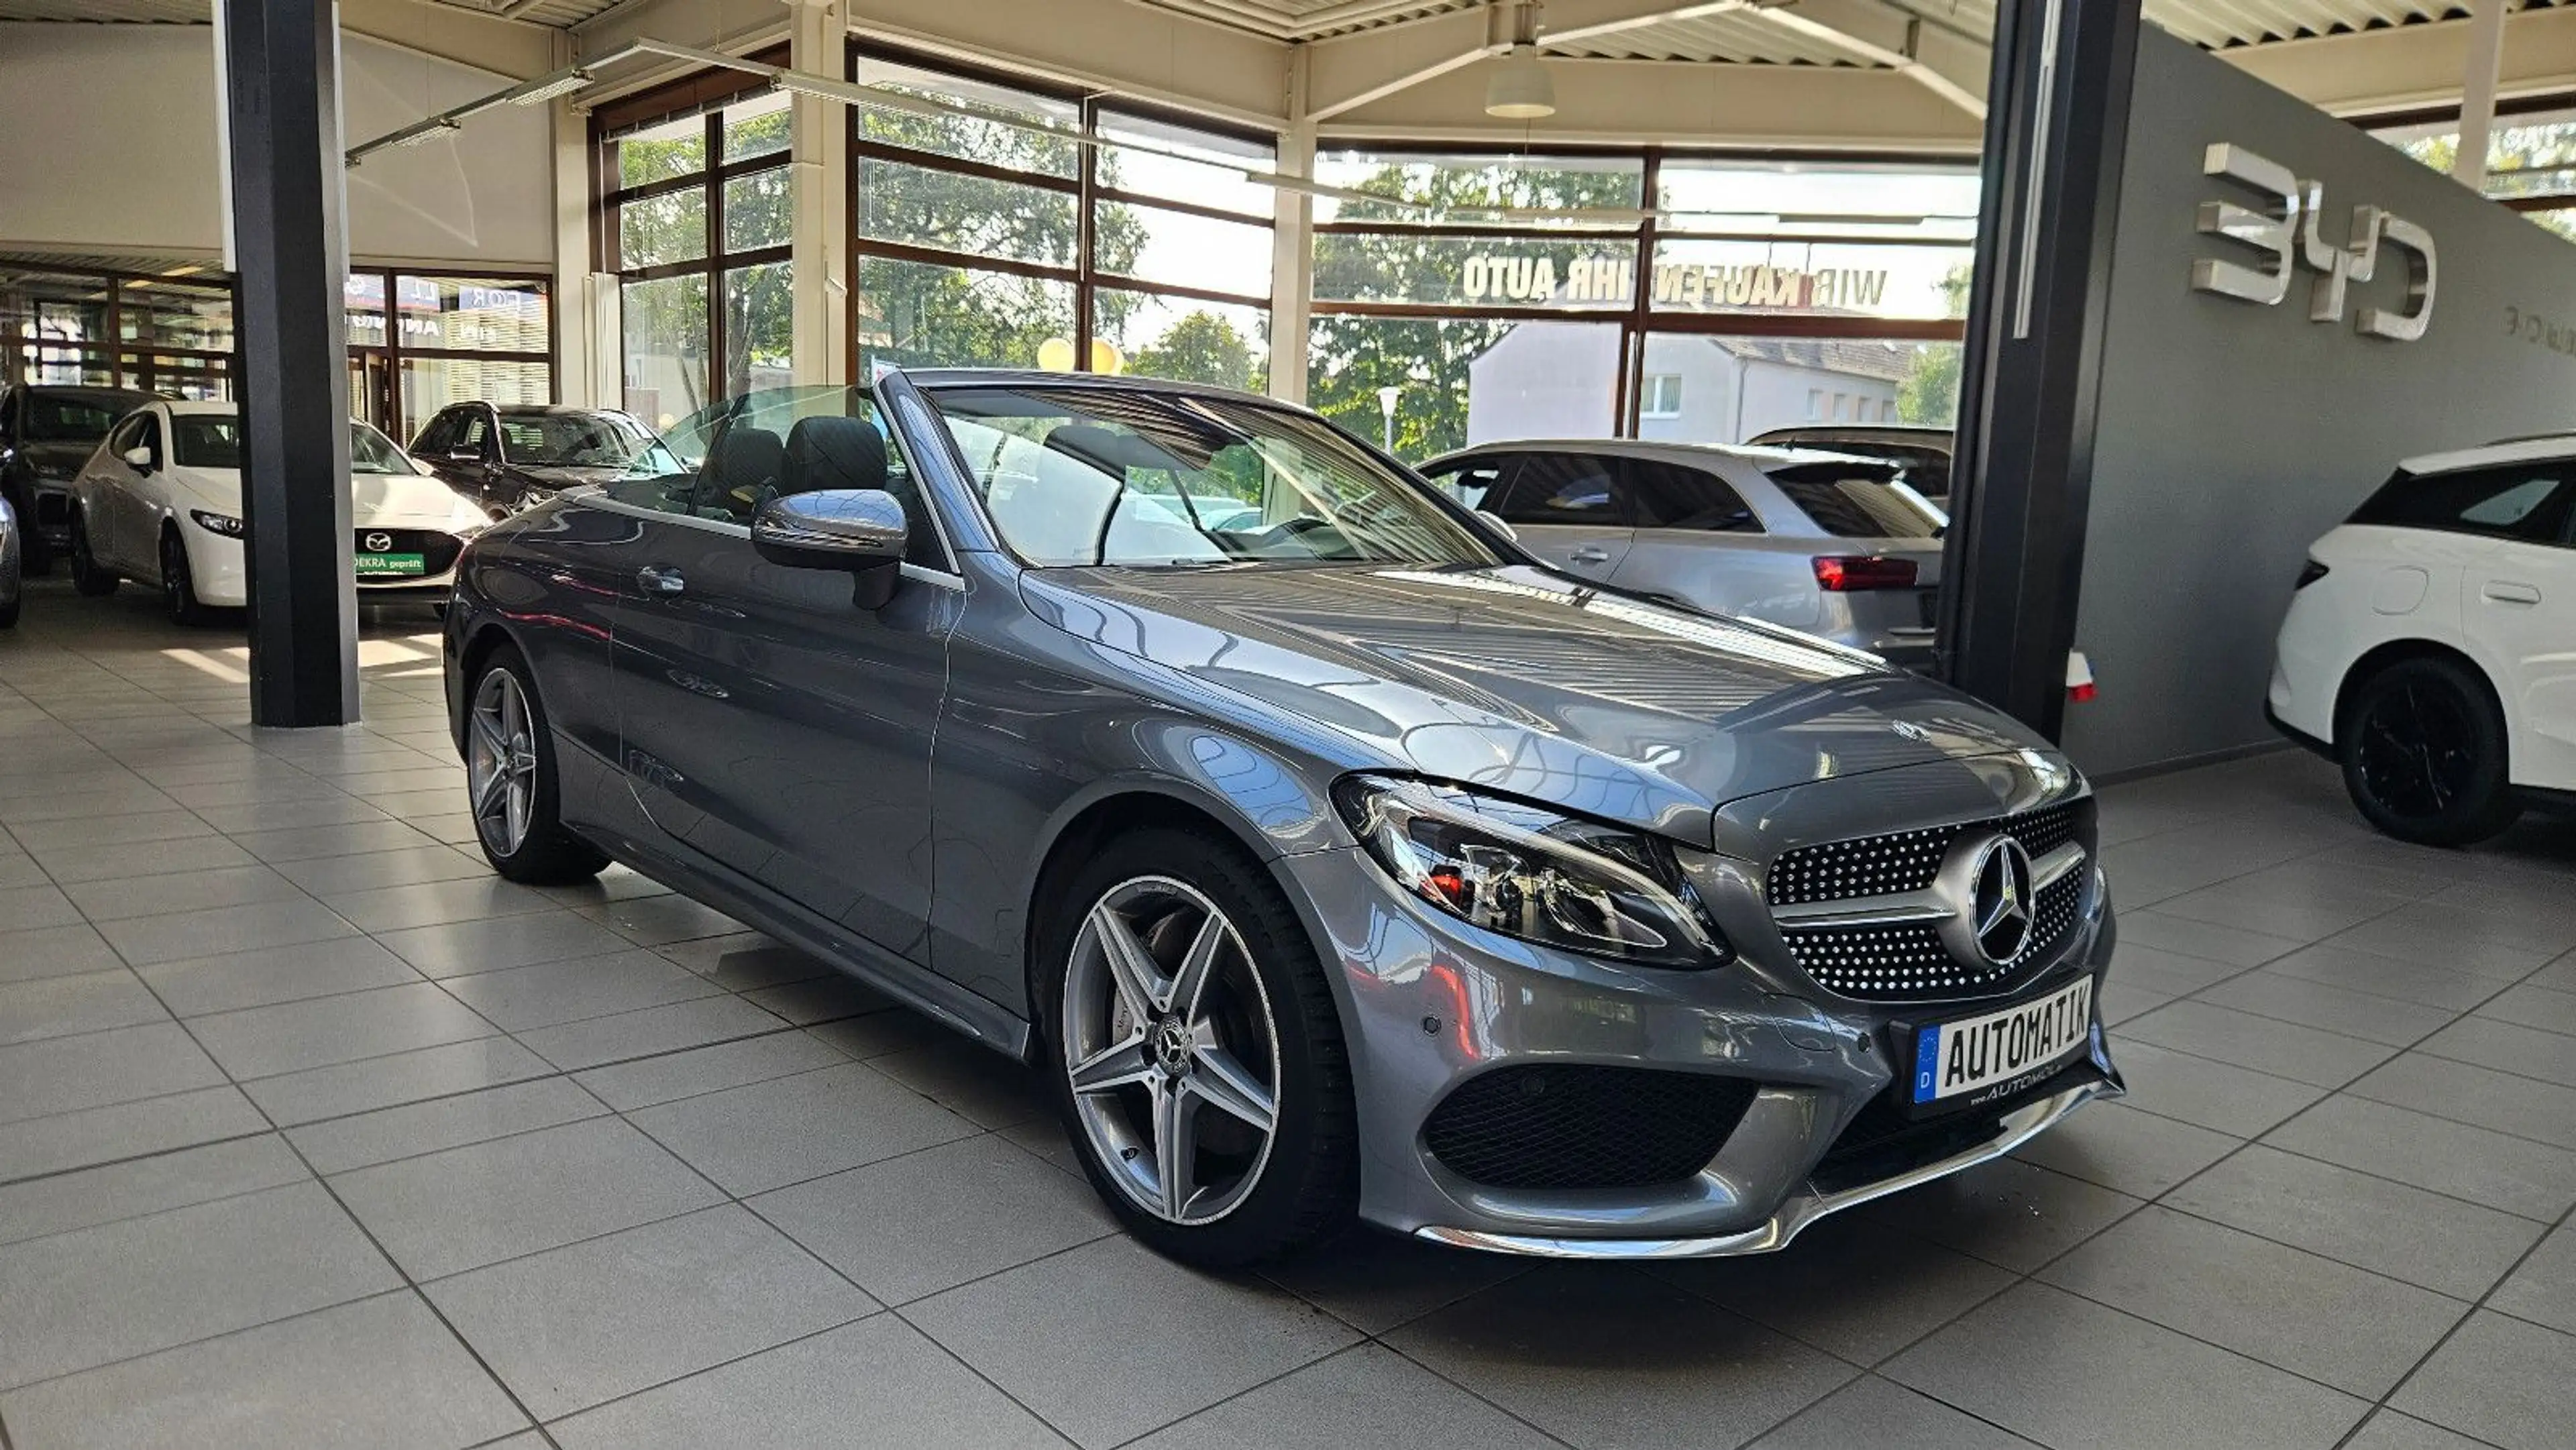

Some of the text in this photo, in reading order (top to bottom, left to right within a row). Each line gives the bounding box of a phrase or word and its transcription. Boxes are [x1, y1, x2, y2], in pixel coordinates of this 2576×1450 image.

[2192, 142, 2438, 341] BYD
[389, 560, 422, 569] geprüft
[1921, 985, 2088, 1089] D AUTOMATIK
